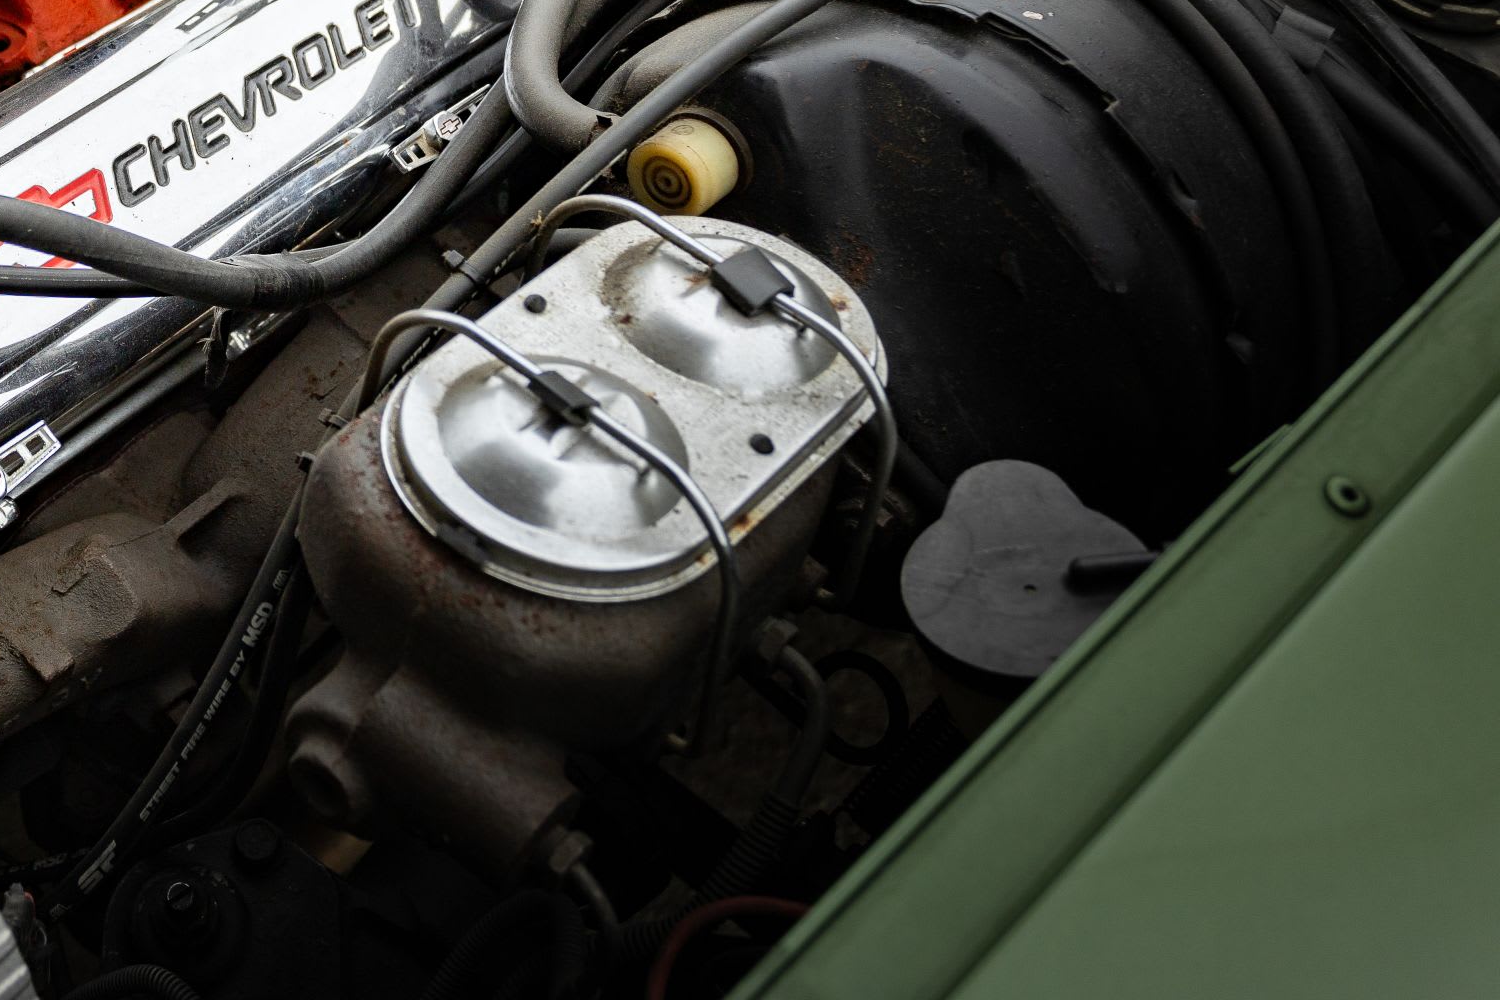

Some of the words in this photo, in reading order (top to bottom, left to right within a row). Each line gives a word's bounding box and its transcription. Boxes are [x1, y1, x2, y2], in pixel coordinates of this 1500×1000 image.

[140, 761, 180, 822] STREET
[181, 722, 206, 760] FIRE
[204, 686, 232, 722] WIRE
[230, 650, 246, 678] BY
[242, 602, 274, 648] MSD
